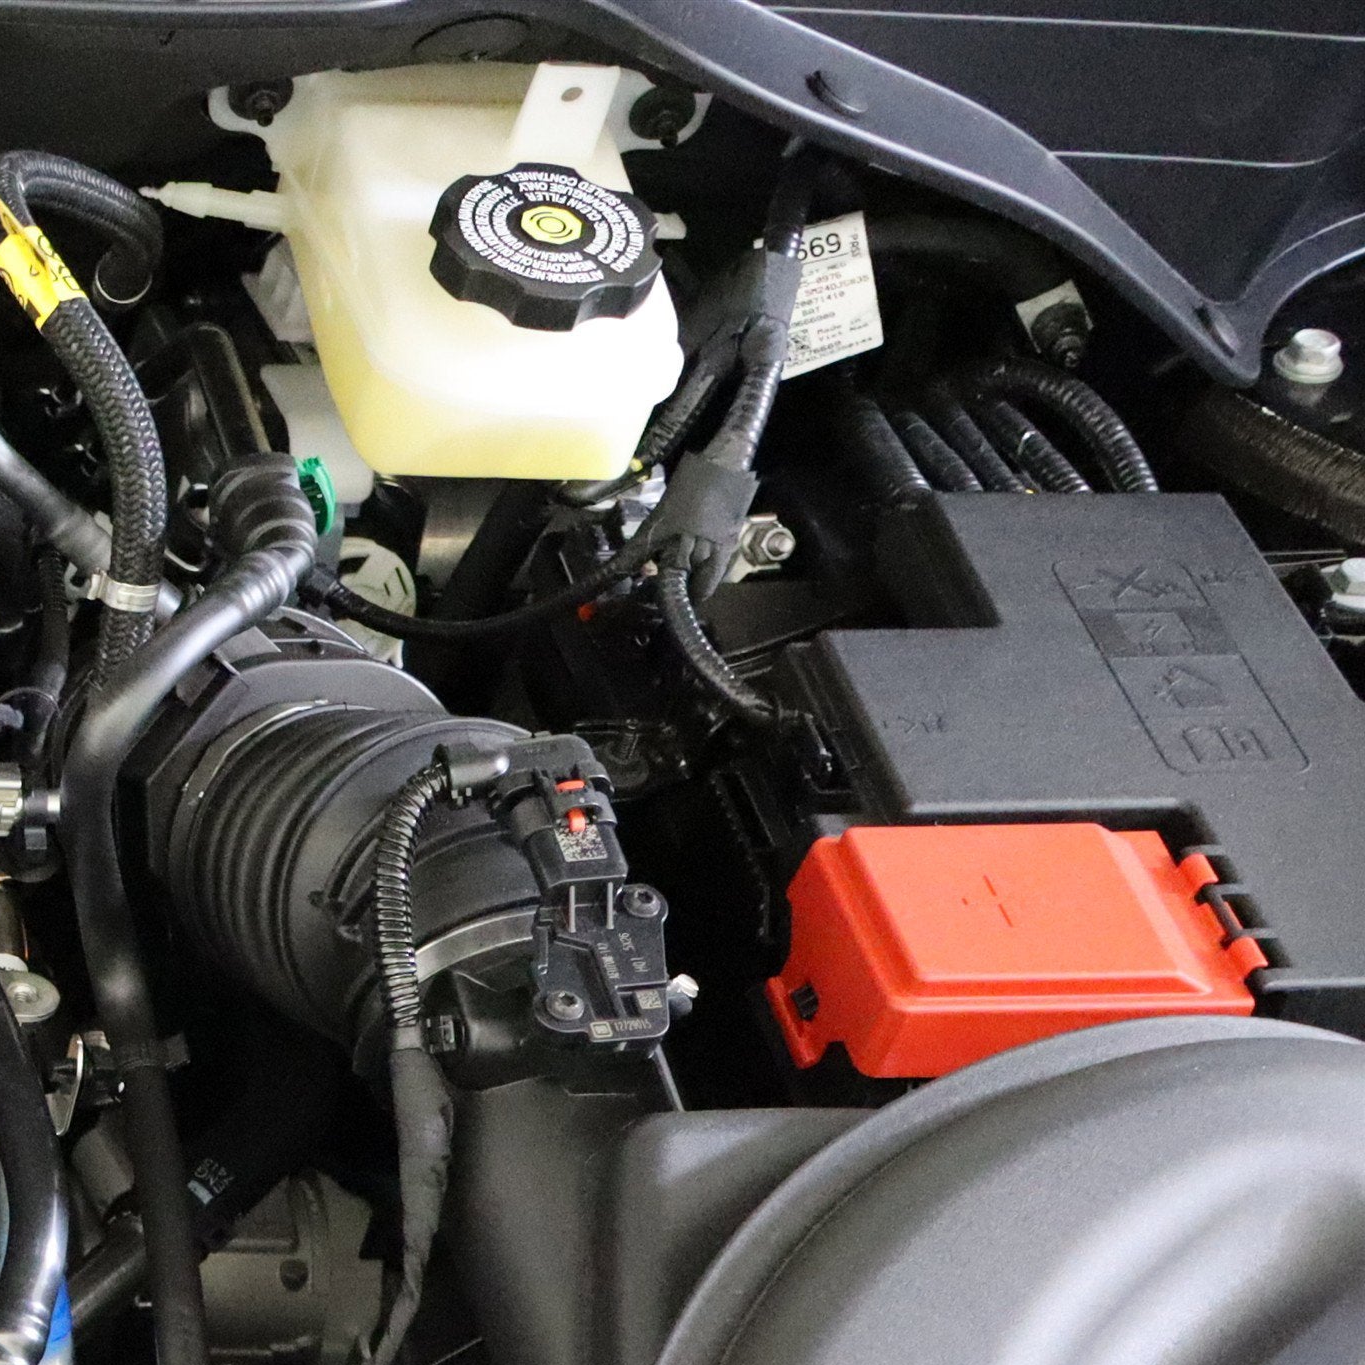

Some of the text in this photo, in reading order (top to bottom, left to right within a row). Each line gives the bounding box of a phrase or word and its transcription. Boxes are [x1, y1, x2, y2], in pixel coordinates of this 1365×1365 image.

[514, 182, 548, 192] ONLY
[549, 182, 573, 195] USE
[576, 180, 622, 205] SEALED
[523, 192, 568, 204] FILLER
[570, 188, 623, 222] REMOVING
[566, 197, 604, 220] CLEAN
[618, 209, 643, 231] FROM
[478, 247, 500, 259] LE
[518, 245, 585, 262] PROVENANT
[490, 254, 545, 280] NETTOYER
